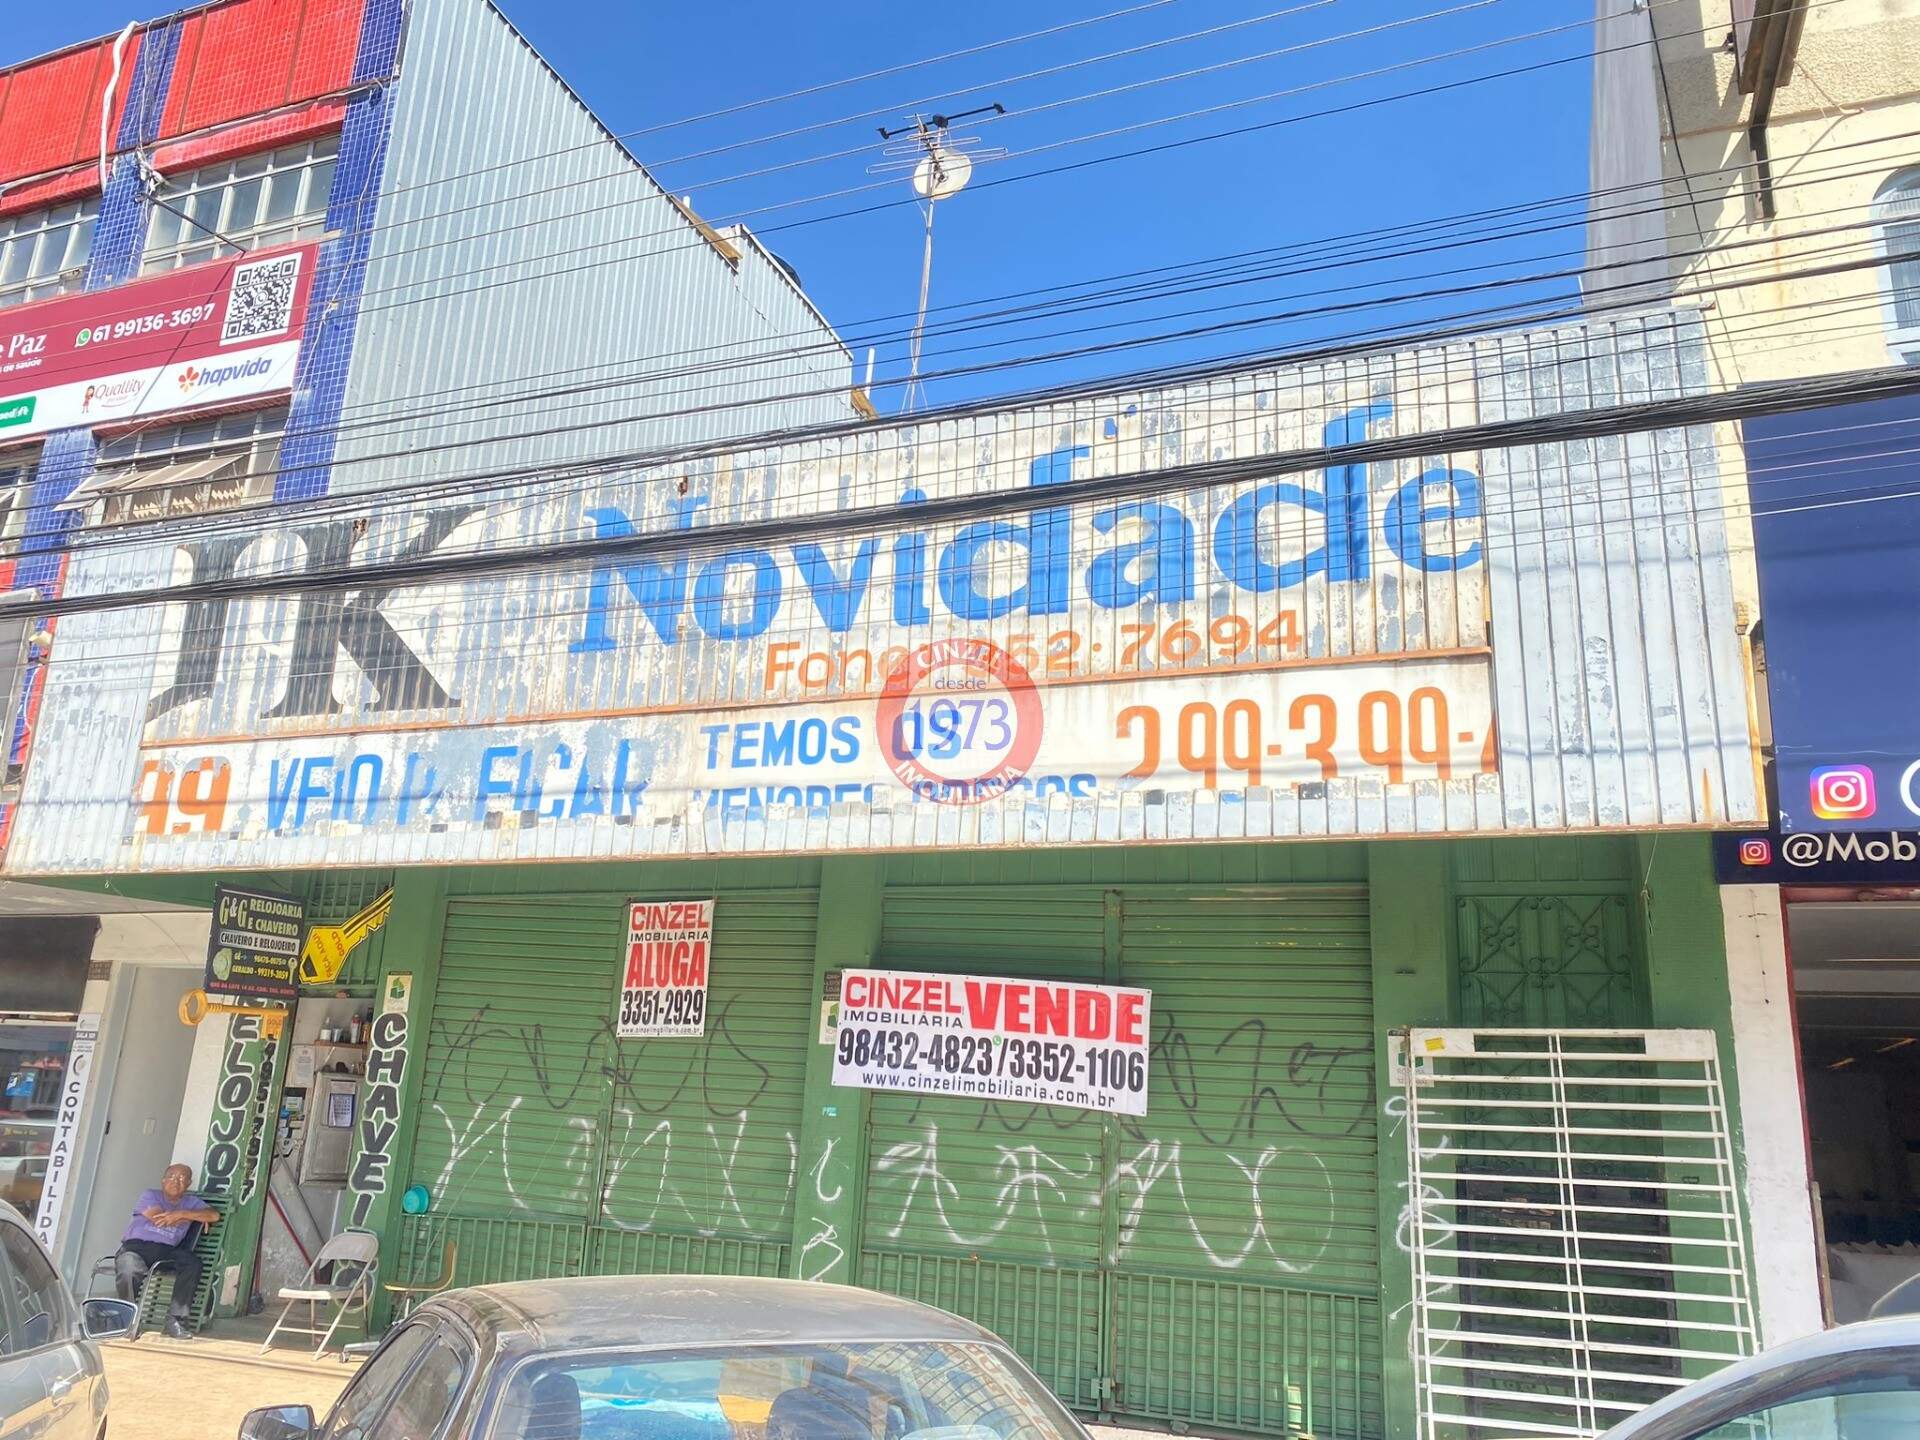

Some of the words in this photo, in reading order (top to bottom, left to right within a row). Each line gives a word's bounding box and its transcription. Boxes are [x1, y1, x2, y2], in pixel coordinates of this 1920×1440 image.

[92, 324, 111, 343] 61
[113, 303, 216, 339] 99136-3697
[8, 333, 48, 359] Paz
[198, 356, 273, 387] hapvida
[568, 398, 1483, 653] Novidade
[700, 715, 862, 771] TEMOS
[891, 708, 963, 761] OS
[219, 896, 248, 928] G&G
[249, 898, 303, 919] RELOJOARIA
[631, 903, 710, 931] CINZEL
[220, 932, 253, 948] CHAVEIRO
[247, 917, 254, 930] E
[255, 918, 299, 937] CHAVEIRO
[625, 941, 705, 988] ALUGA
[621, 990, 704, 1026] 3351-2929
[845, 975, 962, 1014] CINZEL
[963, 980, 1144, 1045] VENDE
